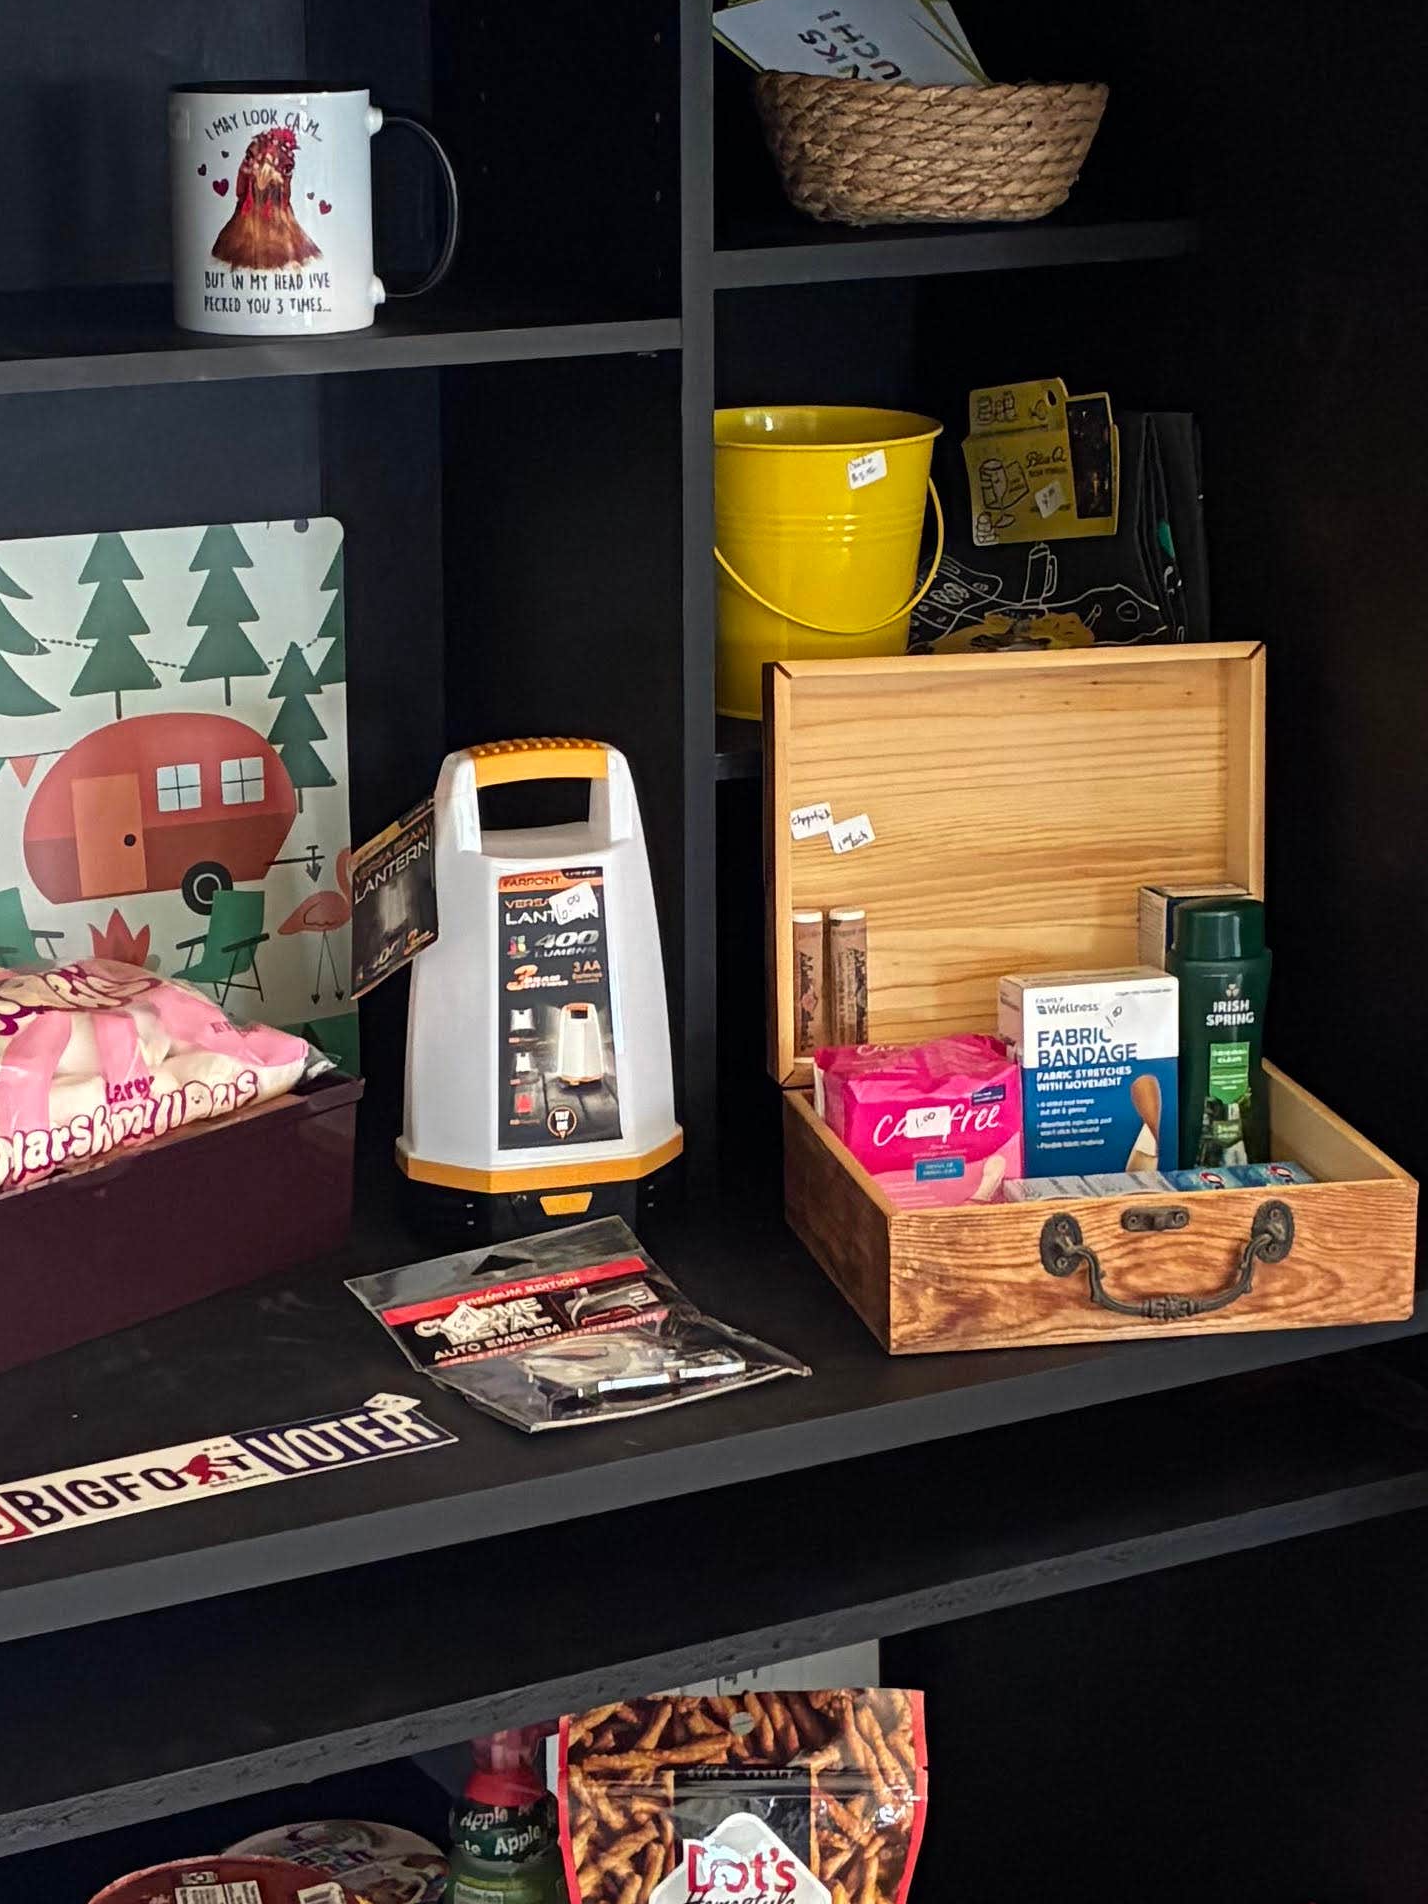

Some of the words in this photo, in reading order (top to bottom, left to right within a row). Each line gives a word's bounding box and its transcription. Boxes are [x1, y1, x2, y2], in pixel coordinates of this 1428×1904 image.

[205, 128, 215, 141] I
[211, 113, 239, 137] MAY
[242, 109, 280, 128] LOOK
[204, 271, 225, 290] BUT
[232, 271, 244, 288] IN
[250, 271, 268, 291] MY
[274, 271, 304, 291] HEAD
[309, 271, 331, 289] I'VE
[246, 297, 271, 314] YOU
[277, 297, 284, 314] 3
[353, 838, 430, 904] LANTERN
[534, 929, 600, 949] 400
[584, 959, 601, 972] AA
[1047, 1001, 1100, 1016] Wellness
[1212, 999, 1251, 1013] IRISH
[1205, 1011, 1256, 1027] SPRING
[1037, 1027, 1112, 1049] FABRIC
[1037, 1042, 1138, 1068] BANDAGE
[1036, 1070, 1072, 1082] FABRIC
[1036, 1082, 1063, 1092] WITH
[1065, 1077, 1122, 1090] MOVEMENT
[872, 1102, 1002, 1148] Cafree
[434, 1341, 482, 1361] AUTO
[485, 1323, 562, 1349] EMBLEM
[246, 1408, 440, 1476] VOTER
[460, 1805, 509, 1831] Apple
[494, 1823, 542, 1857] Apple
[687, 1843, 798, 1894] Dot's
